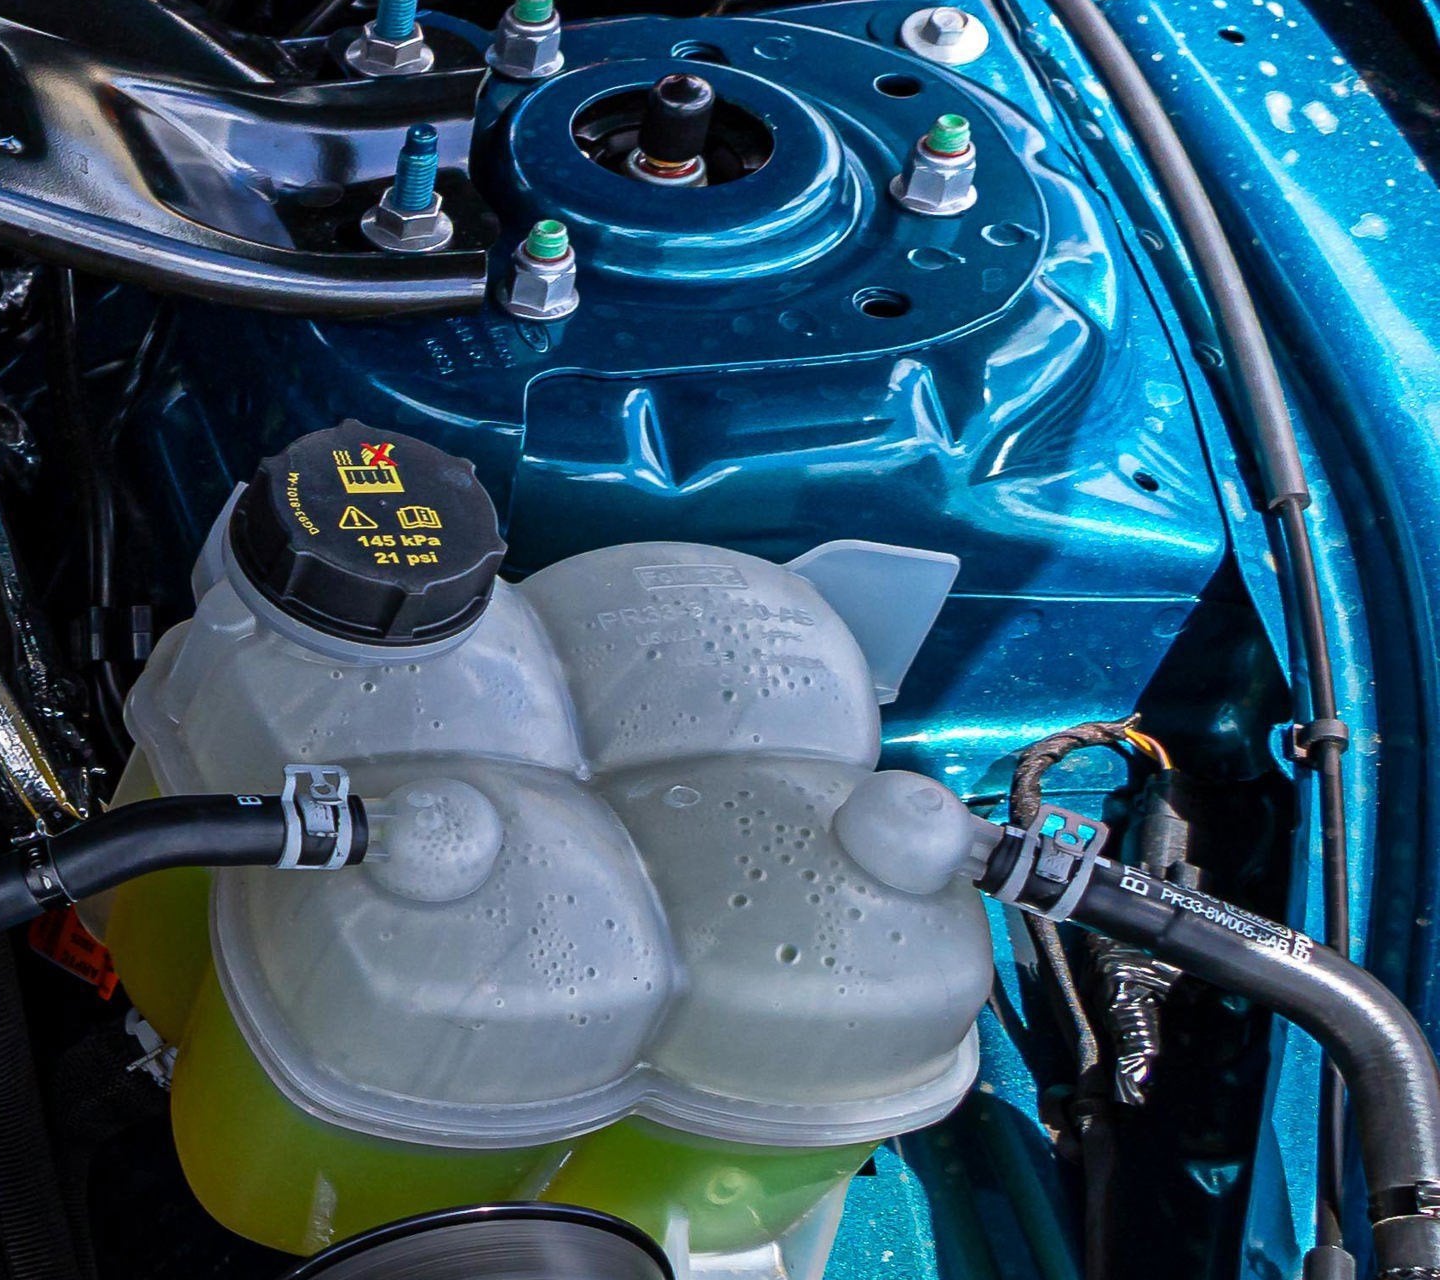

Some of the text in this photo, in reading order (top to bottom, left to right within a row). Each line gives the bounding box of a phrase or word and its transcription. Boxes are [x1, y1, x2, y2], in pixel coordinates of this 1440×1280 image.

[357, 534, 442, 548] 145 kPa
[375, 551, 439, 566] 21 psi
